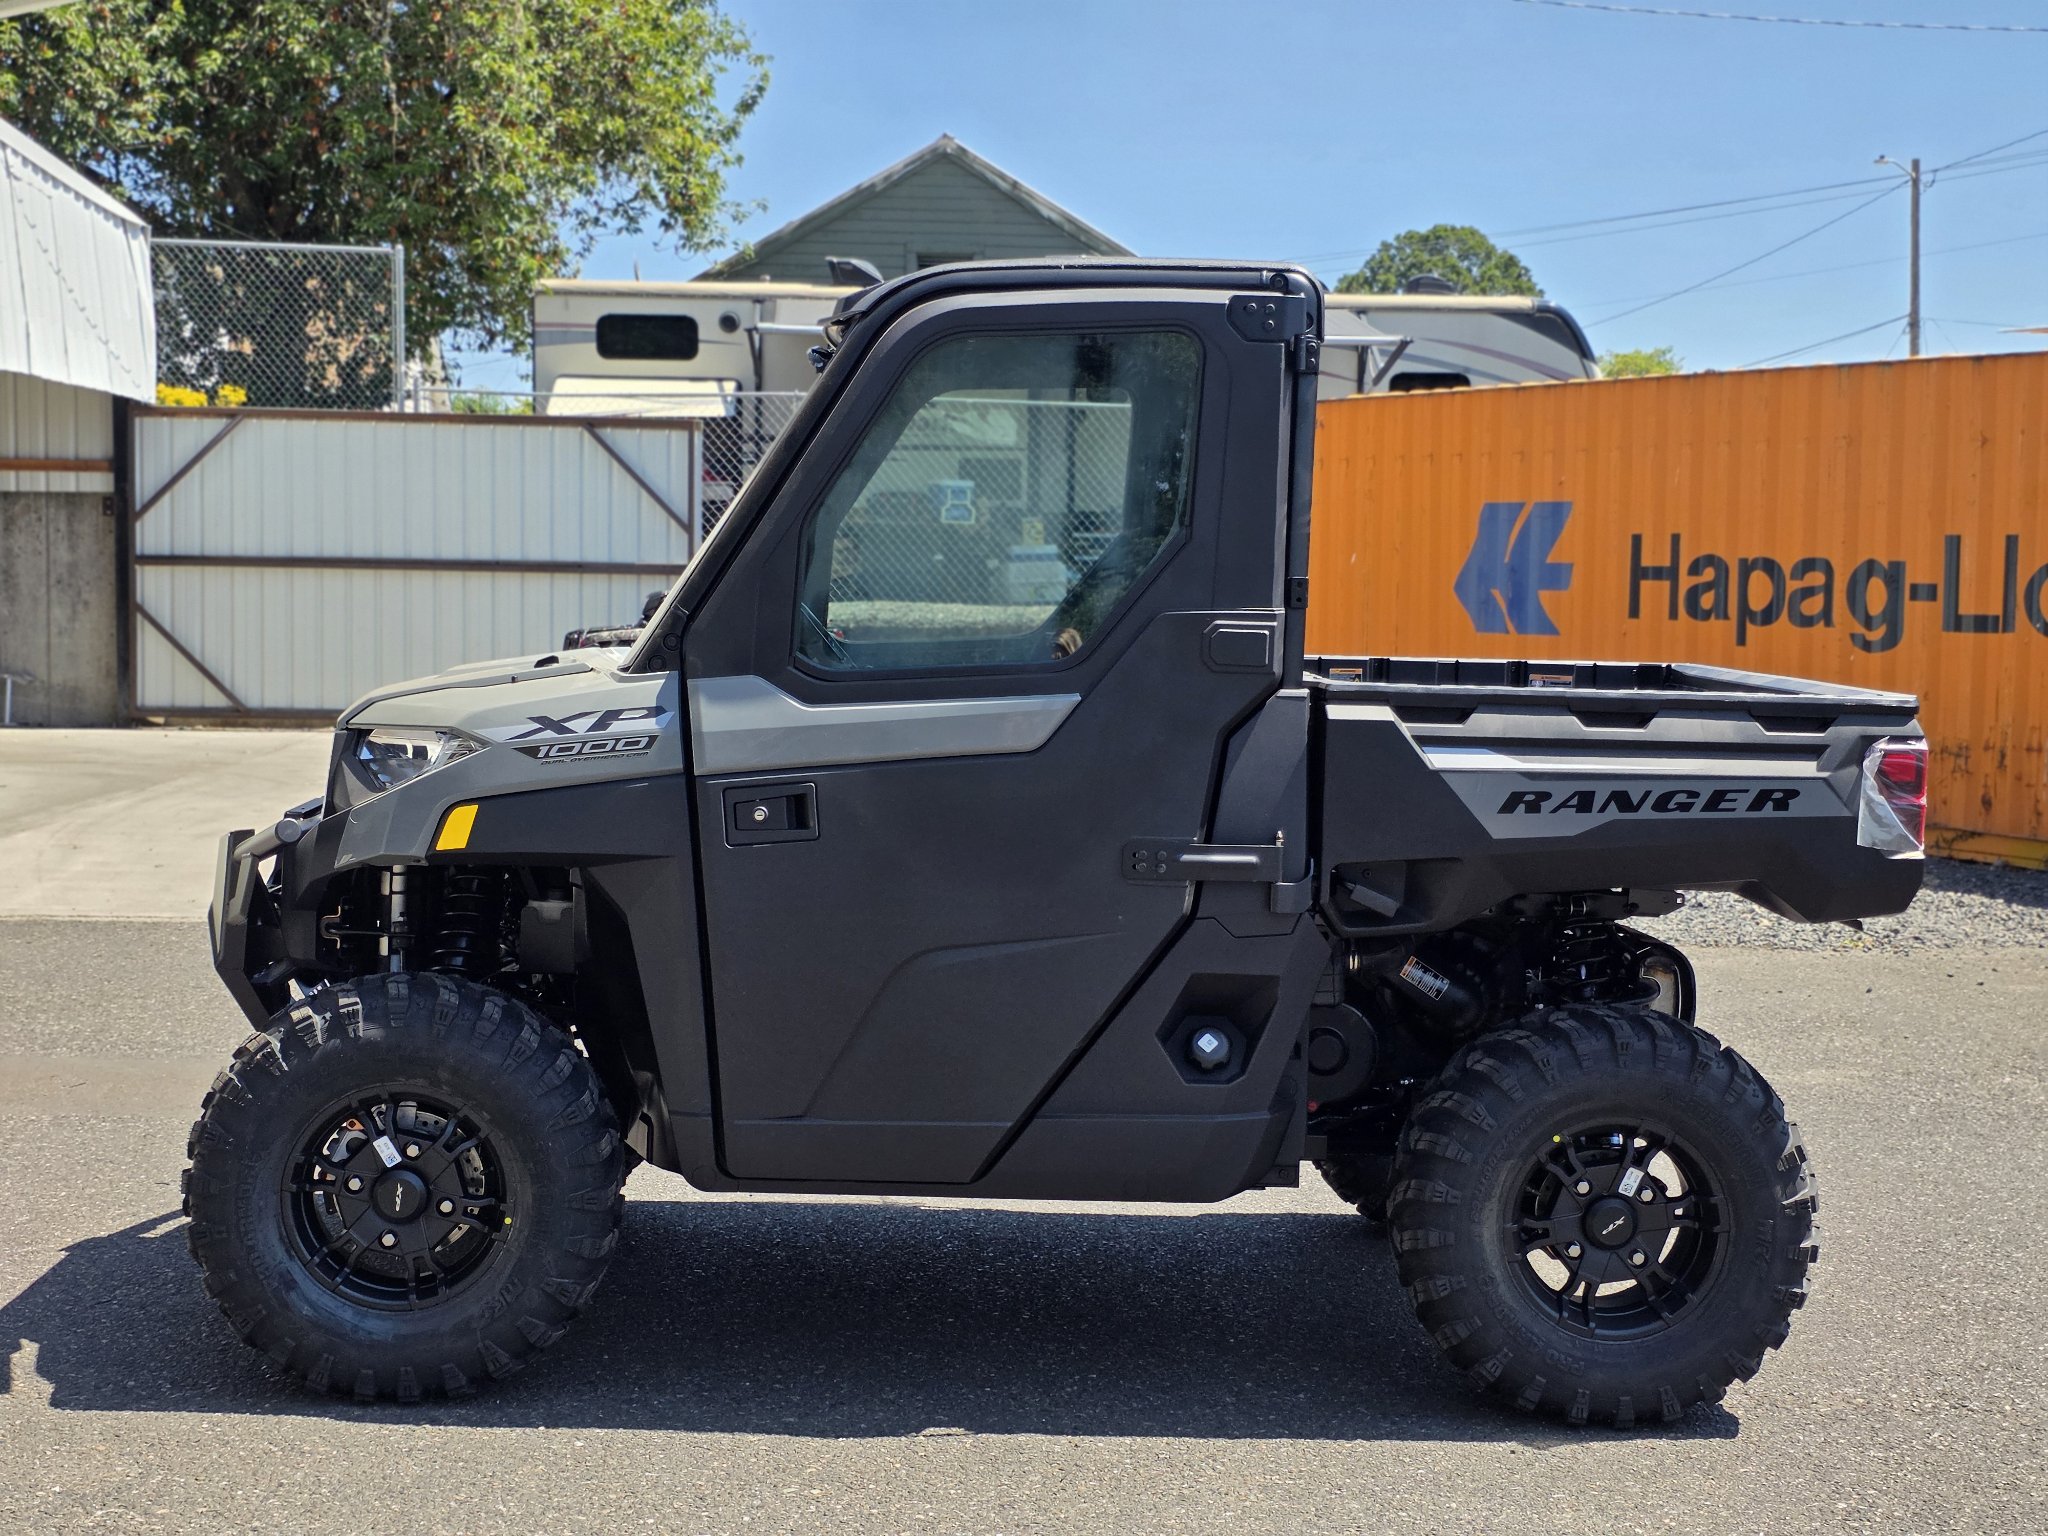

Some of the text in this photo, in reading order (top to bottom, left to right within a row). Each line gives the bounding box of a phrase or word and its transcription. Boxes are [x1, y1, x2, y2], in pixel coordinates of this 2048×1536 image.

[503, 705, 668, 741] XP
[536, 737, 649, 758] 1000
[540, 758, 568, 766] DUAL
[570, 753, 625, 763] OVERHEAD
[1496, 788, 1801, 814] RANGER
